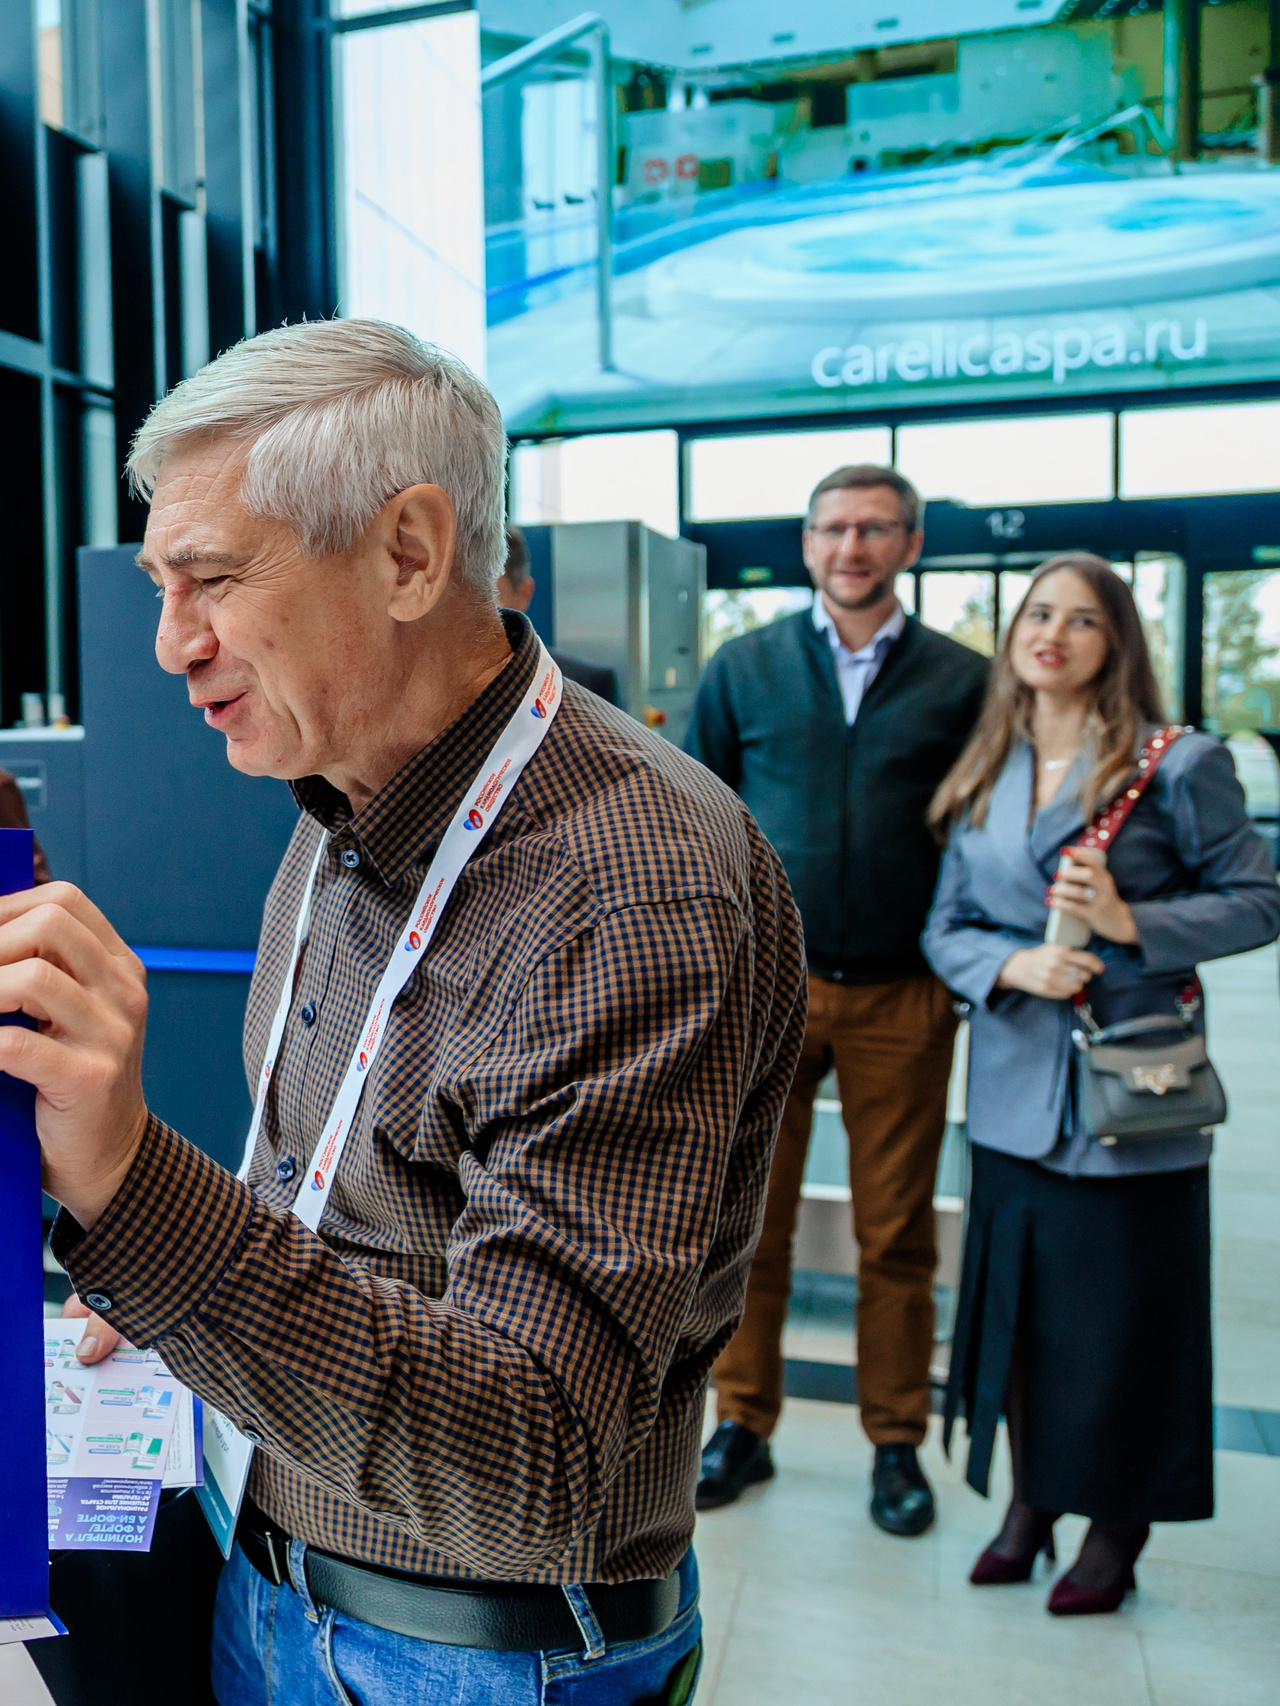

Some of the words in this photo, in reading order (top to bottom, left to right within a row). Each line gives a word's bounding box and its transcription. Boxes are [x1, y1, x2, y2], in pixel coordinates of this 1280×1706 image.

[811, 316, 1208, 388] carelicaspa.ru
[987, 509, 1026, 539] 12
[474, 772, 497, 807] РОССИЙСКОЕ
[479, 758, 512, 809] КАРДИОЛОГИЧЕСКОЕ
[485, 783, 504, 812] ОБЩЕСТВО
[415, 893, 433, 929] РОССИЙСКОЕ
[420, 876, 445, 931] КАРДИОЛОГИЧЕСКОЕ
[424, 904, 438, 934] ОБЩЕСТВО
[76, 1514, 136, 1523] БИ-ФОРТЕ
[88, 1524, 134, 1533] ФОРТЕ/
[137, 1525, 146, 1533] А
[65, 1533, 75, 1541] А
